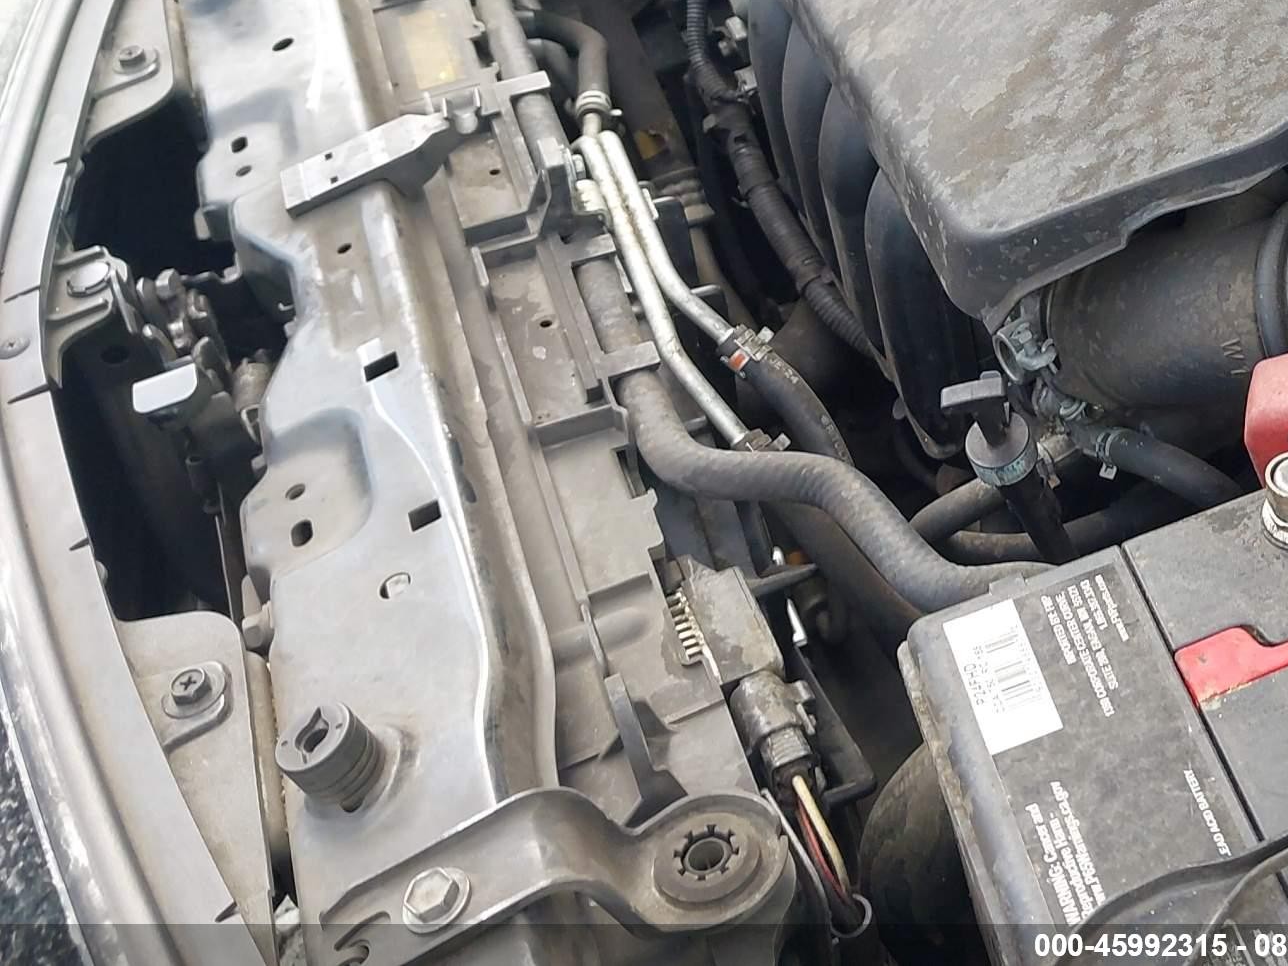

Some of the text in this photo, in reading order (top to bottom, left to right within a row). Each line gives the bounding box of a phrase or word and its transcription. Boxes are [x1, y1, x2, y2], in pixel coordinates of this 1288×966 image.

[1183, 766, 1209, 811] BATTERY
[1201, 808, 1220, 834] ACID
[1024, 802, 1081, 926] WARNING: Cancer and
